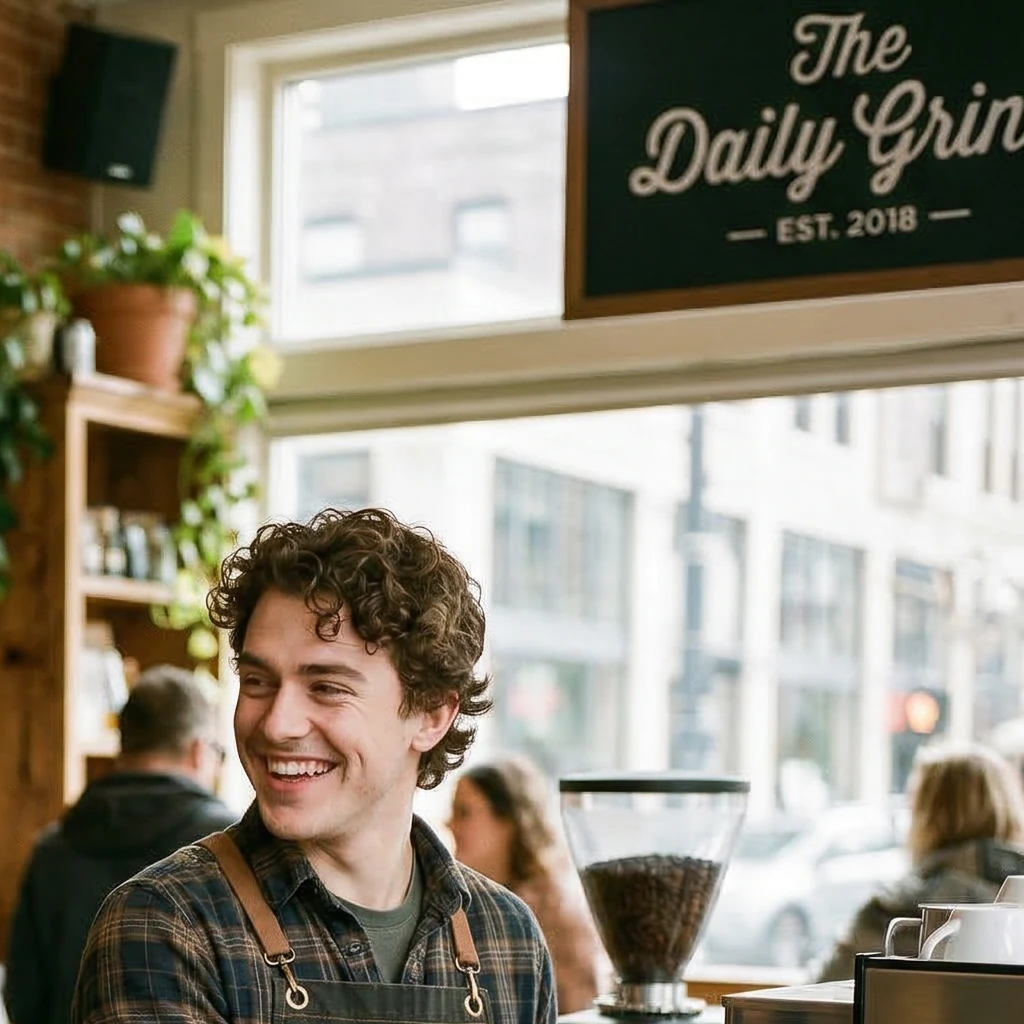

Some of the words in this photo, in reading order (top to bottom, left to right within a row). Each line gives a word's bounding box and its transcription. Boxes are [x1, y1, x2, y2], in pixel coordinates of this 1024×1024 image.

[790, 12, 912, 86] The
[628, 102, 845, 203] Daily
[776, 213, 840, 244] EST.
[846, 205, 919, 237] 2018
